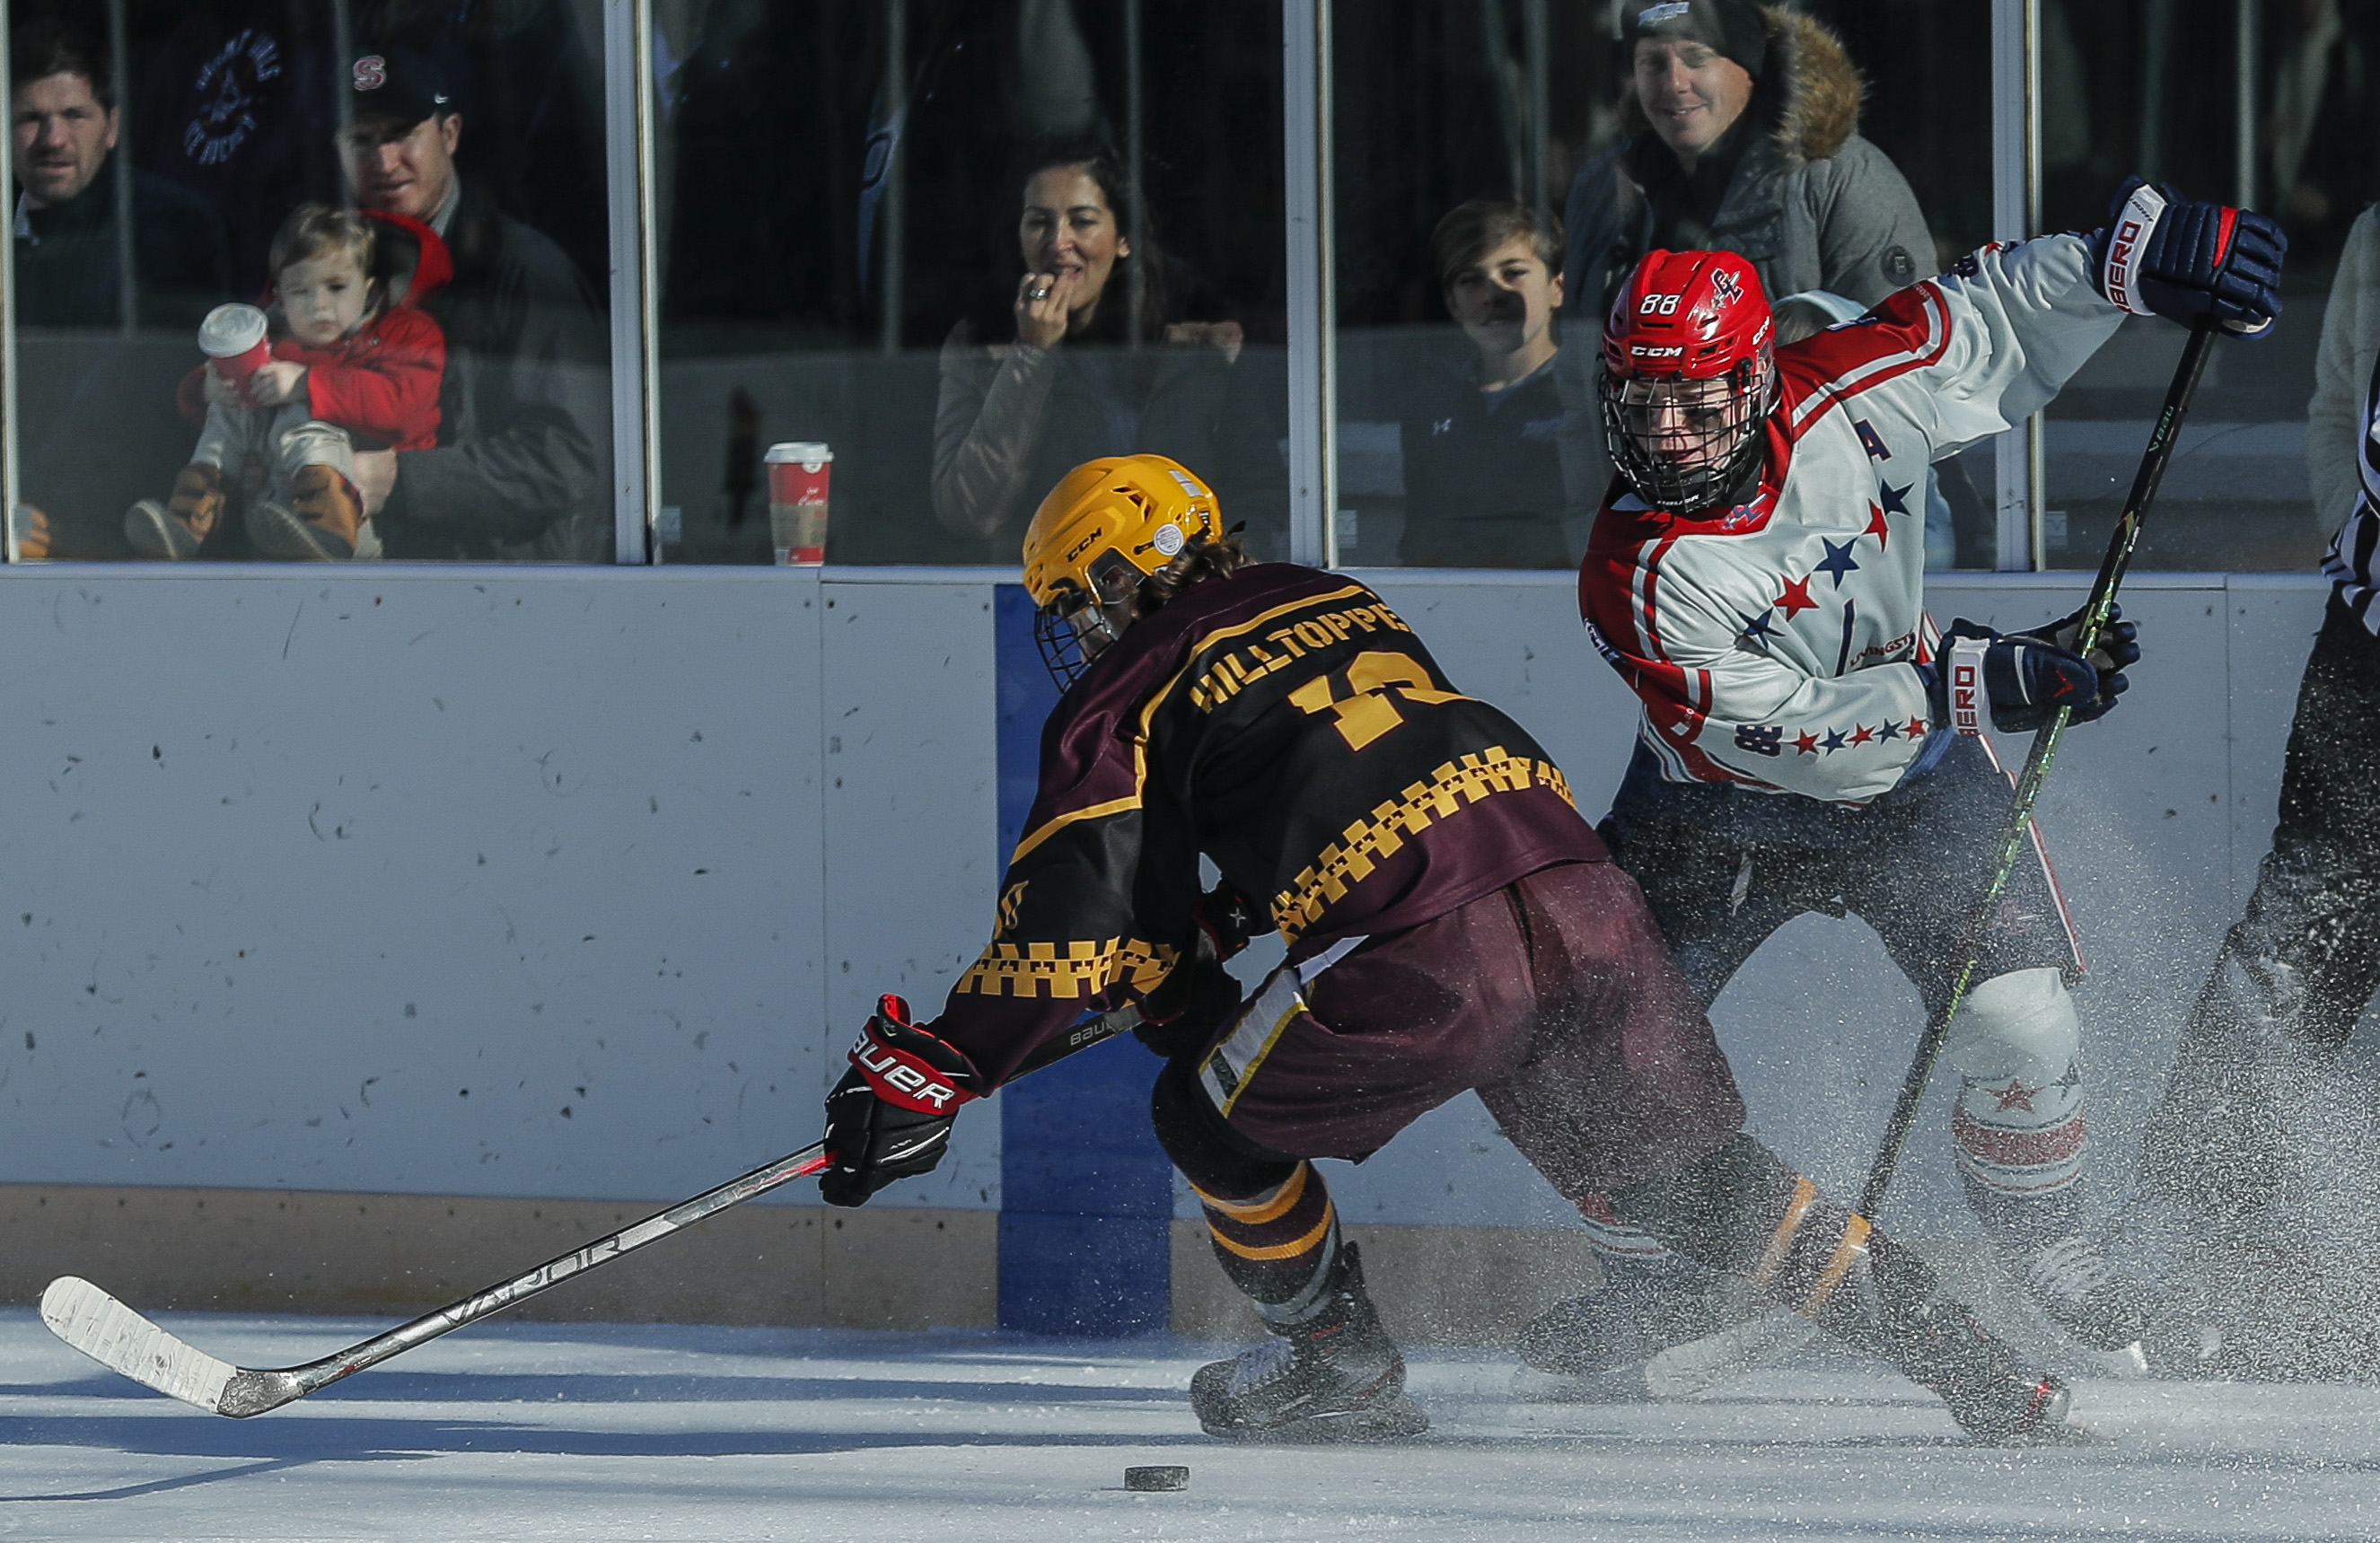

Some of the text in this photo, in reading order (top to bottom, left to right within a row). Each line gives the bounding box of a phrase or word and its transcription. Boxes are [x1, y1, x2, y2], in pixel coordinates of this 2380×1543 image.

[353, 55, 387, 91] S
[1639, 293, 1682, 315] 88
[1629, 345, 1684, 358] CCM
[1854, 417, 1893, 462] A
[1067, 526, 1102, 563] CCM
[442, 1234, 623, 1328] VAPOR
